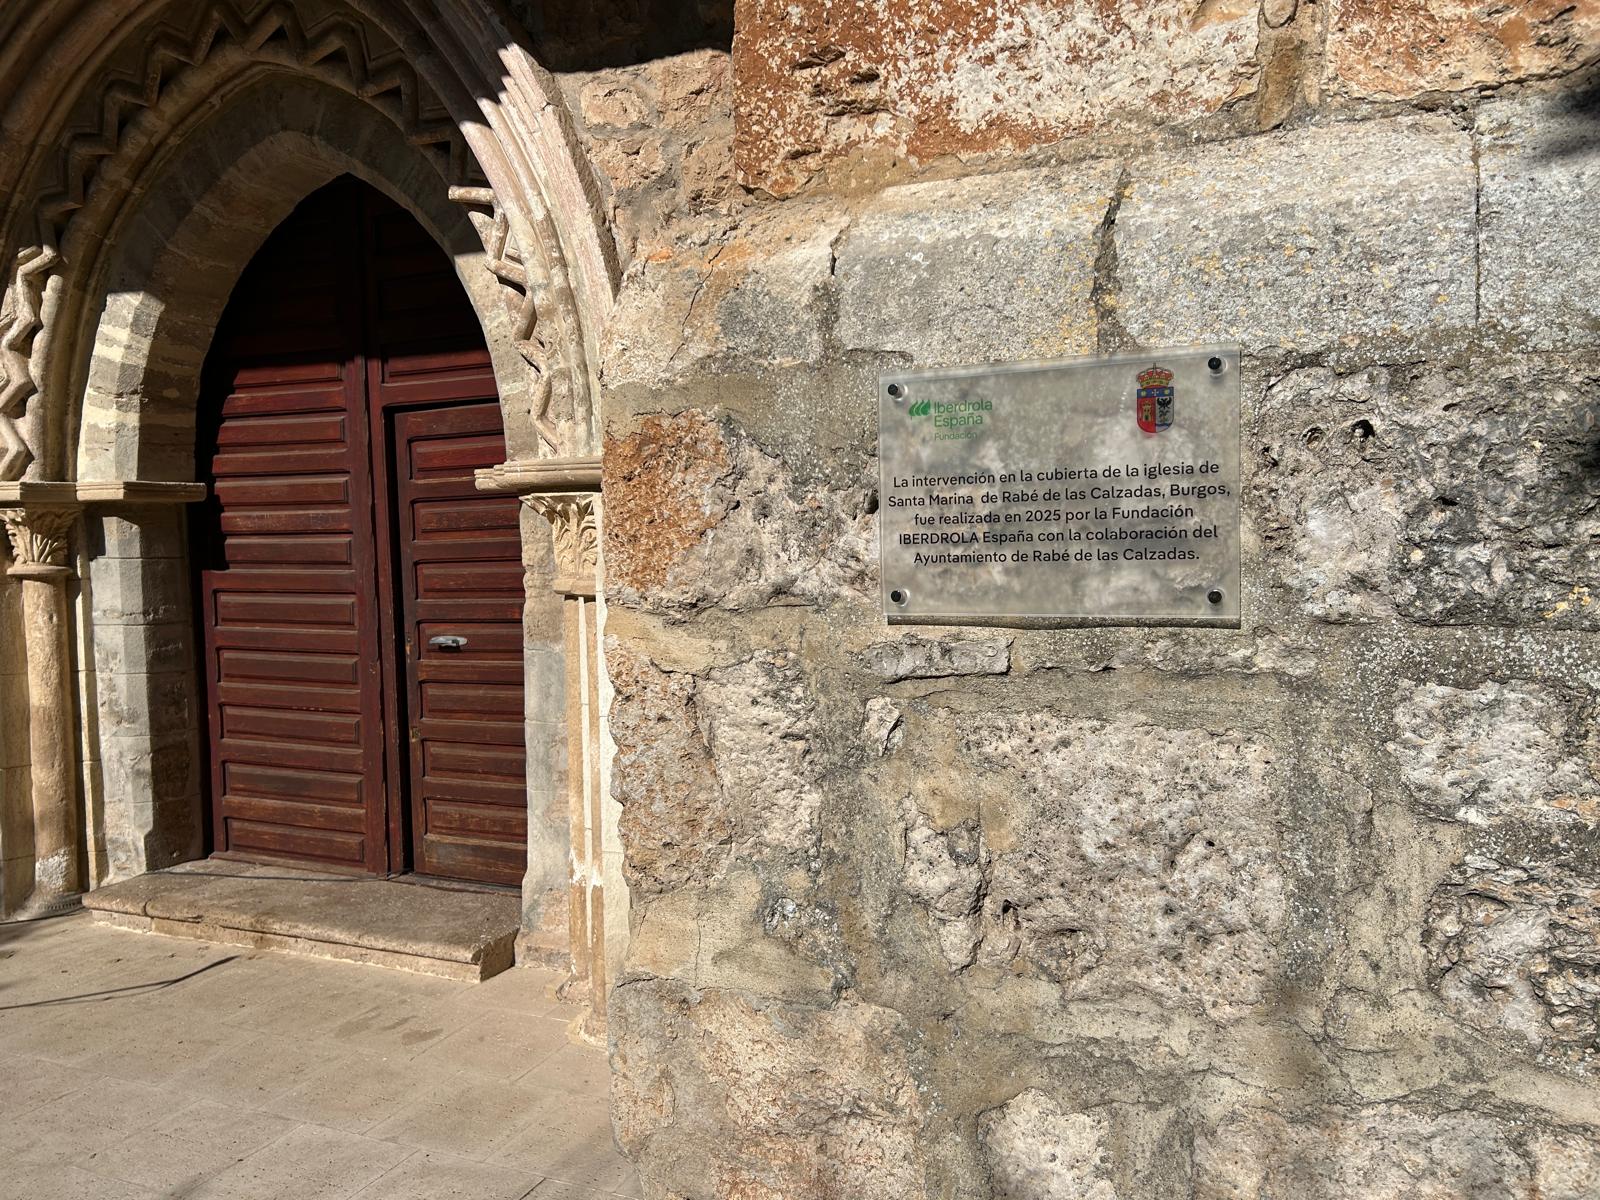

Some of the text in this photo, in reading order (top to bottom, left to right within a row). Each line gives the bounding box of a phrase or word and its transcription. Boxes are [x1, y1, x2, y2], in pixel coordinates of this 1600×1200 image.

[934, 399, 993, 413] Iberdrola
[934, 412, 983, 428] España
[934, 430, 977, 440] Fundación
[893, 461, 1219, 487] La intervención en la cubierta de la iglesia de
[888, 483, 1230, 506] Santa Marina de Rabé de las Calzadas, Burgos,
[915, 504, 1193, 524] fue realizada en 2025 por la Fundación
[899, 525, 1218, 545] IBERDROLA España con la colaboración del
[914, 546, 1200, 565] Ayuntamiento de Rabé de las Calzadas.
